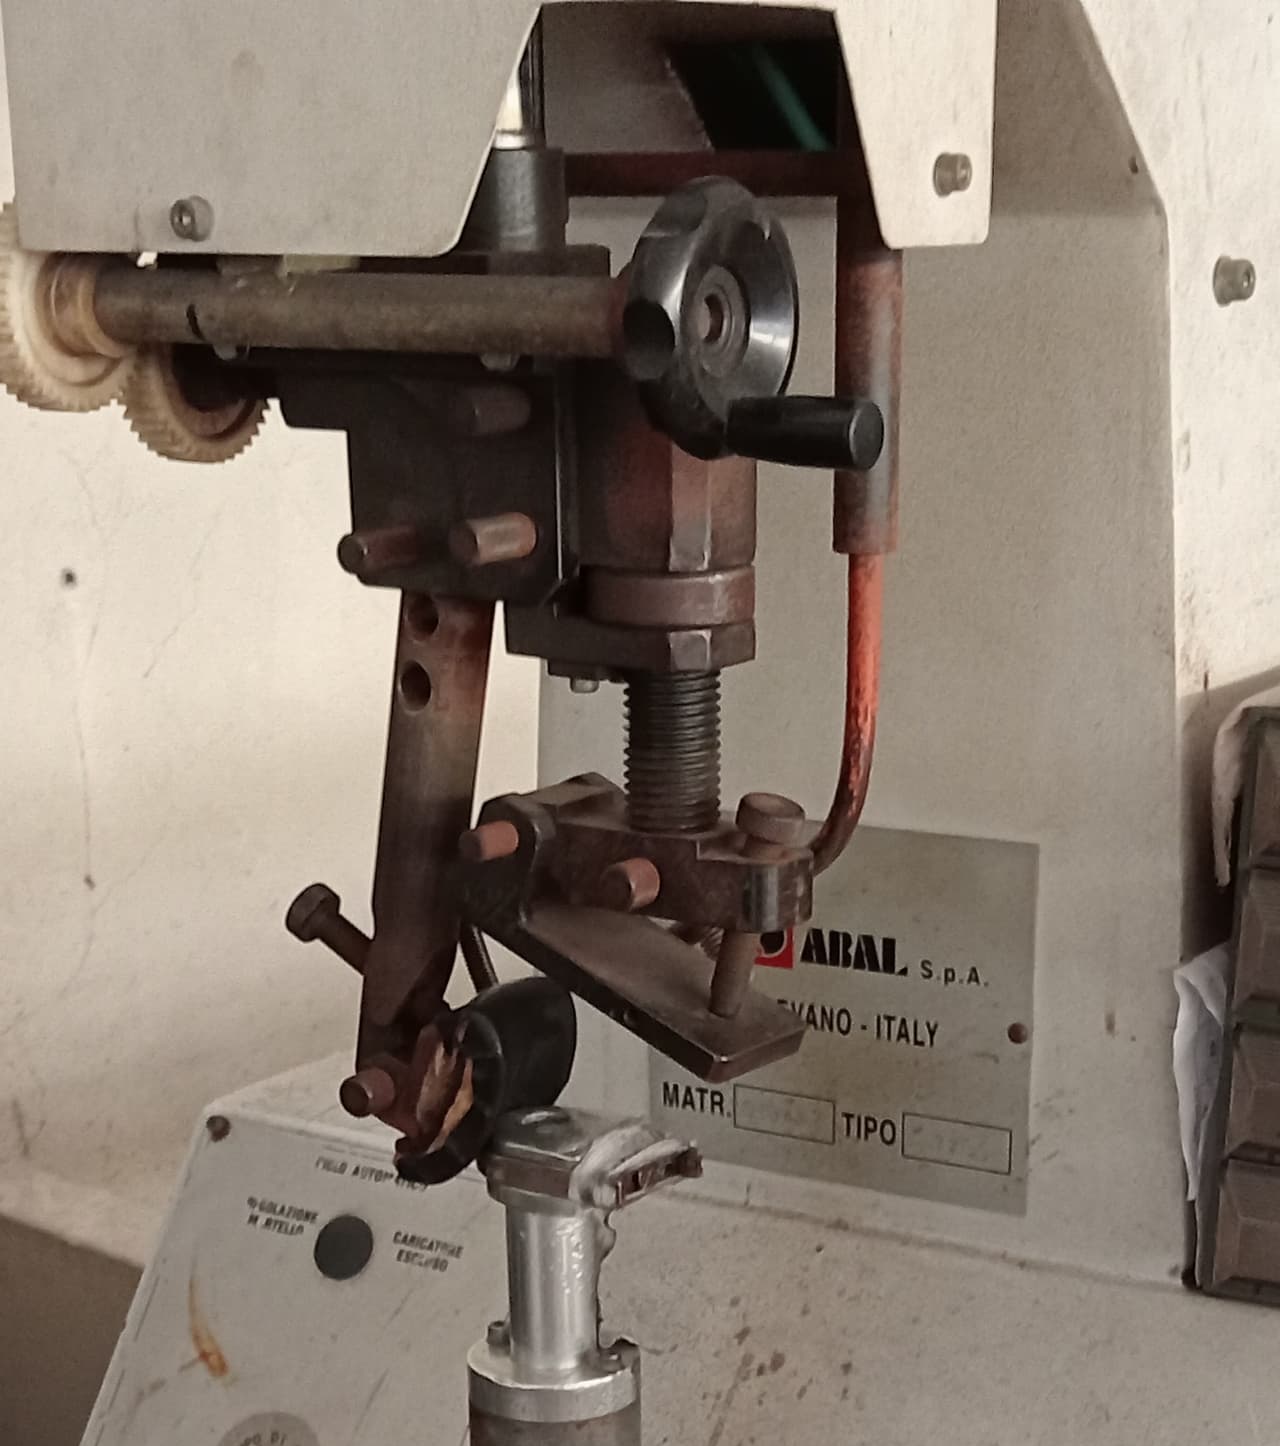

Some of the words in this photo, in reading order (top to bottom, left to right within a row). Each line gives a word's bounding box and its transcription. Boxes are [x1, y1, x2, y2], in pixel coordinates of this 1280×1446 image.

[921, 958, 989, 988] S.p.A.
[777, 998, 852, 1036] VANO
[876, 1013, 939, 1048] ITALY
[662, 1081, 732, 1119] MATR.
[841, 1112, 897, 1147] TIPO
